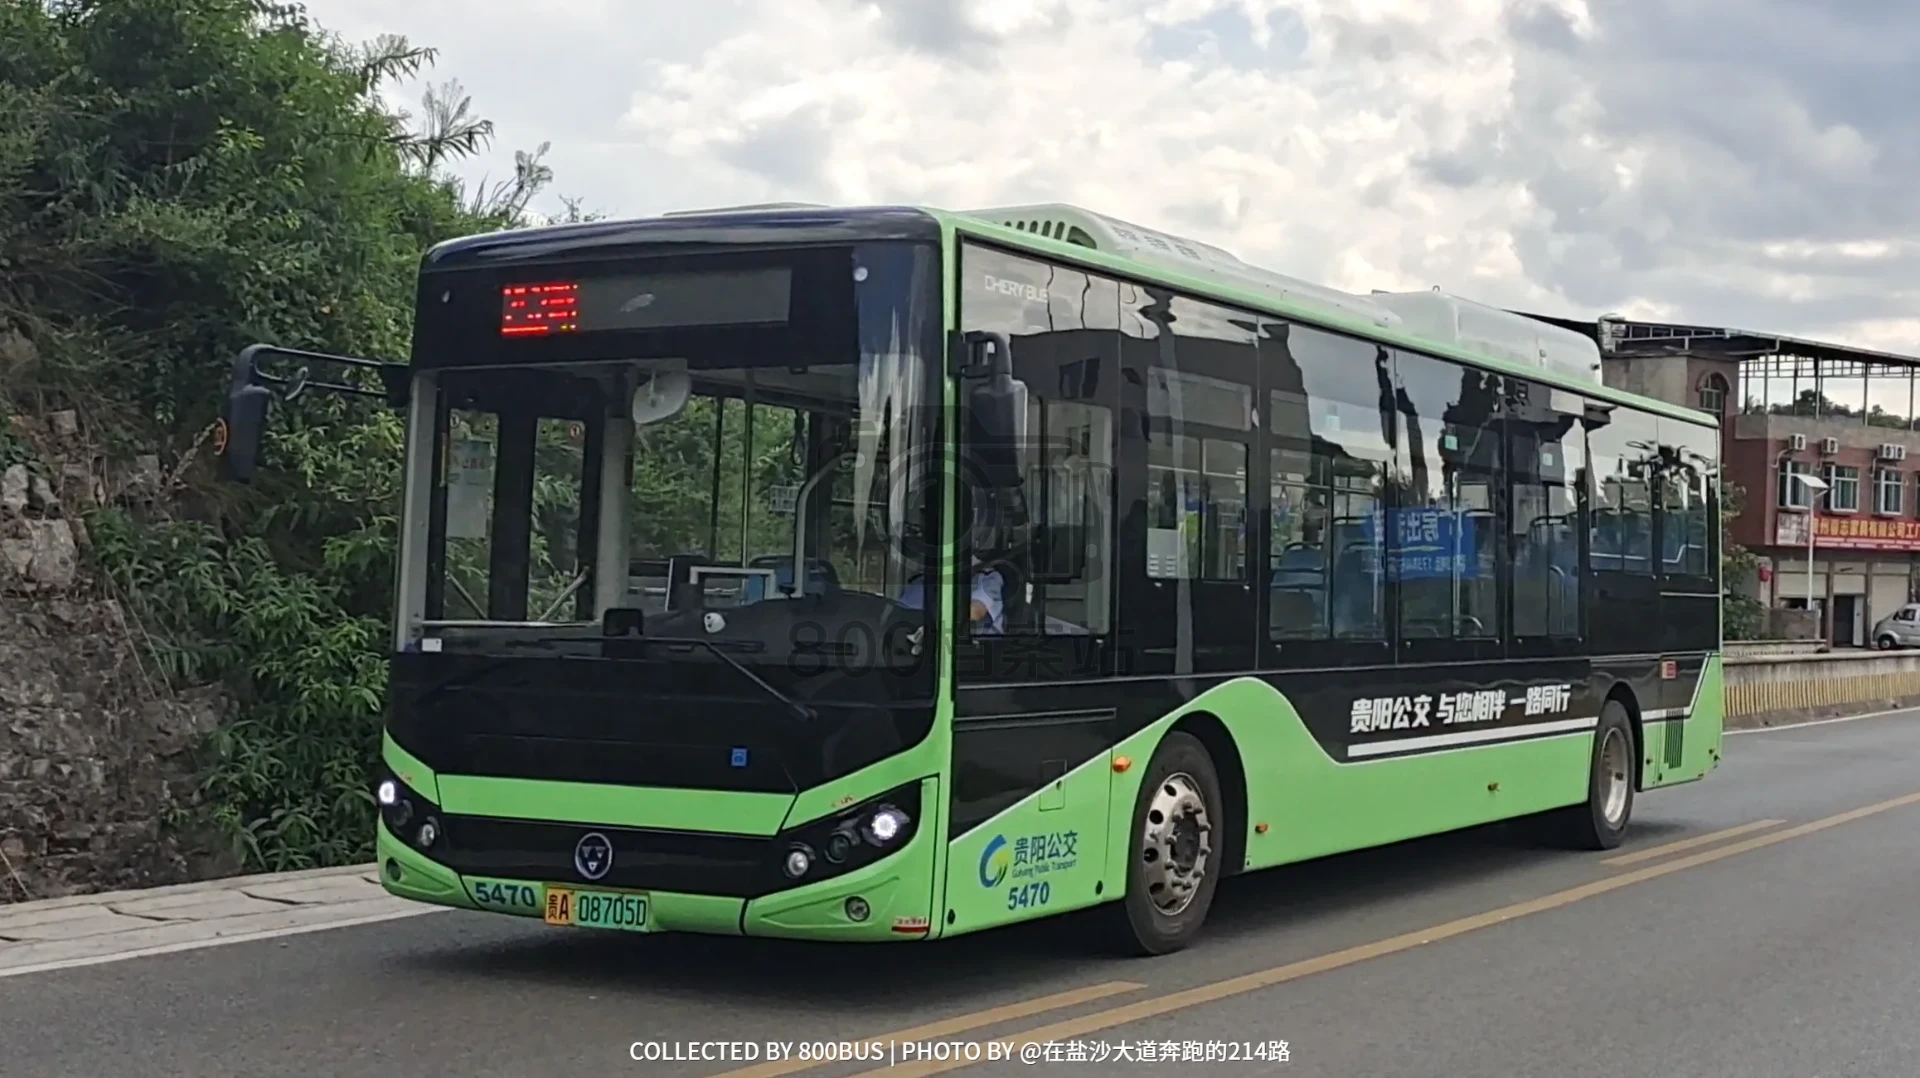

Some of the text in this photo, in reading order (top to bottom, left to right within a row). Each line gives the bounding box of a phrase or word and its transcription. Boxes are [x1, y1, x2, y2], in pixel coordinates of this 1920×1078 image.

[985, 274, 1025, 297] CHERY
[1350, 684, 1570, 733] 贵阳公交 与您相伴 一路同行
[1013, 829, 1078, 867] 贵阳公交
[475, 882, 537, 908] 5470
[1007, 881, 1050, 910] 5470
